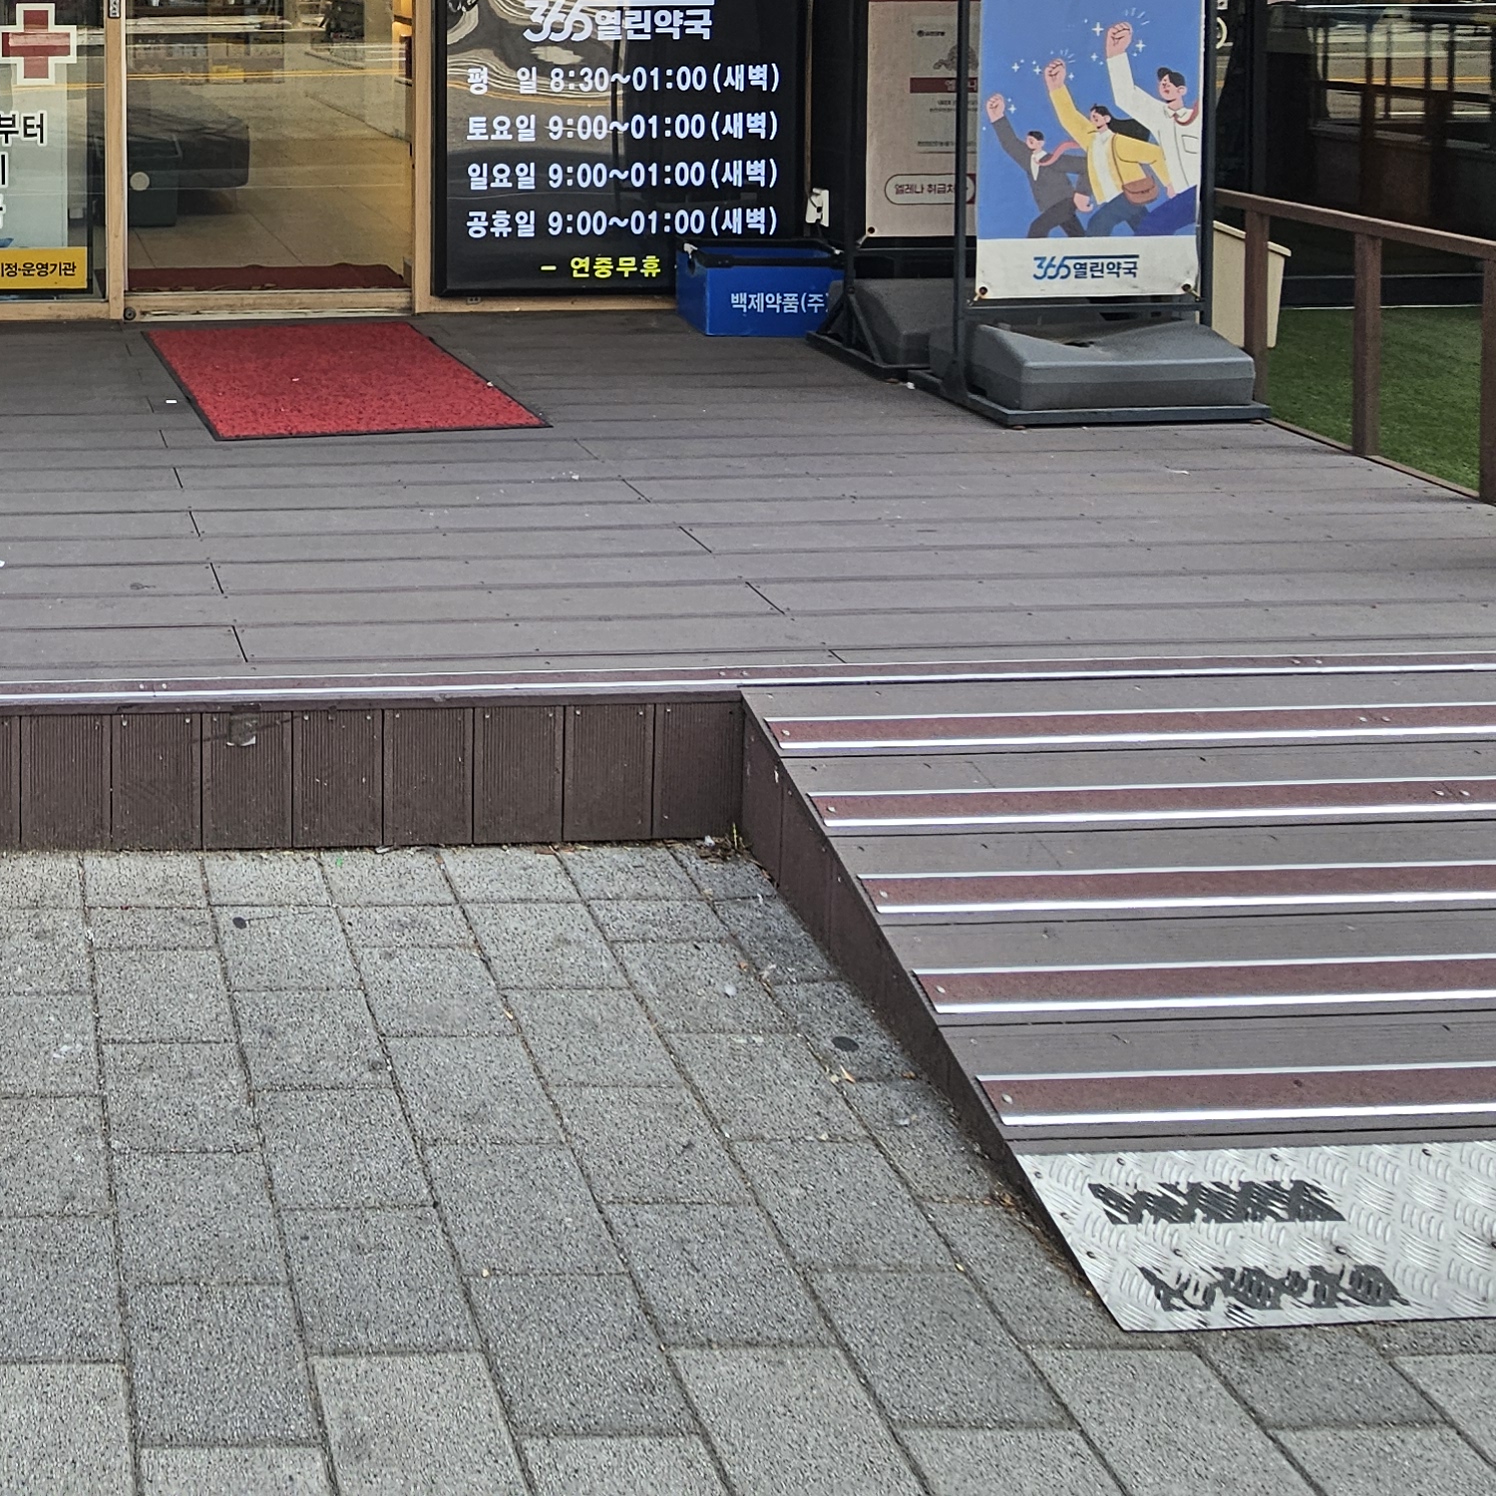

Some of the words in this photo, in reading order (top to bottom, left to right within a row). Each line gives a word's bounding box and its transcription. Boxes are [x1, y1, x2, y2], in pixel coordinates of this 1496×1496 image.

[549, 62, 780, 94] 8:30~01:00(새벽)
[466, 113, 537, 143] 토요일
[547, 110, 779, 142] 9:00~01:00(새벽)
[467, 161, 537, 191] 일요일
[547, 158, 779, 190] 9:00~01:00(새벽)
[466, 209, 537, 239] 공휴일
[547, 206, 779, 238] 9:00~01:00(새벽)
[569, 255, 662, 280] 연중무휴
[1033, 253, 1140, 281] 365열린약국
